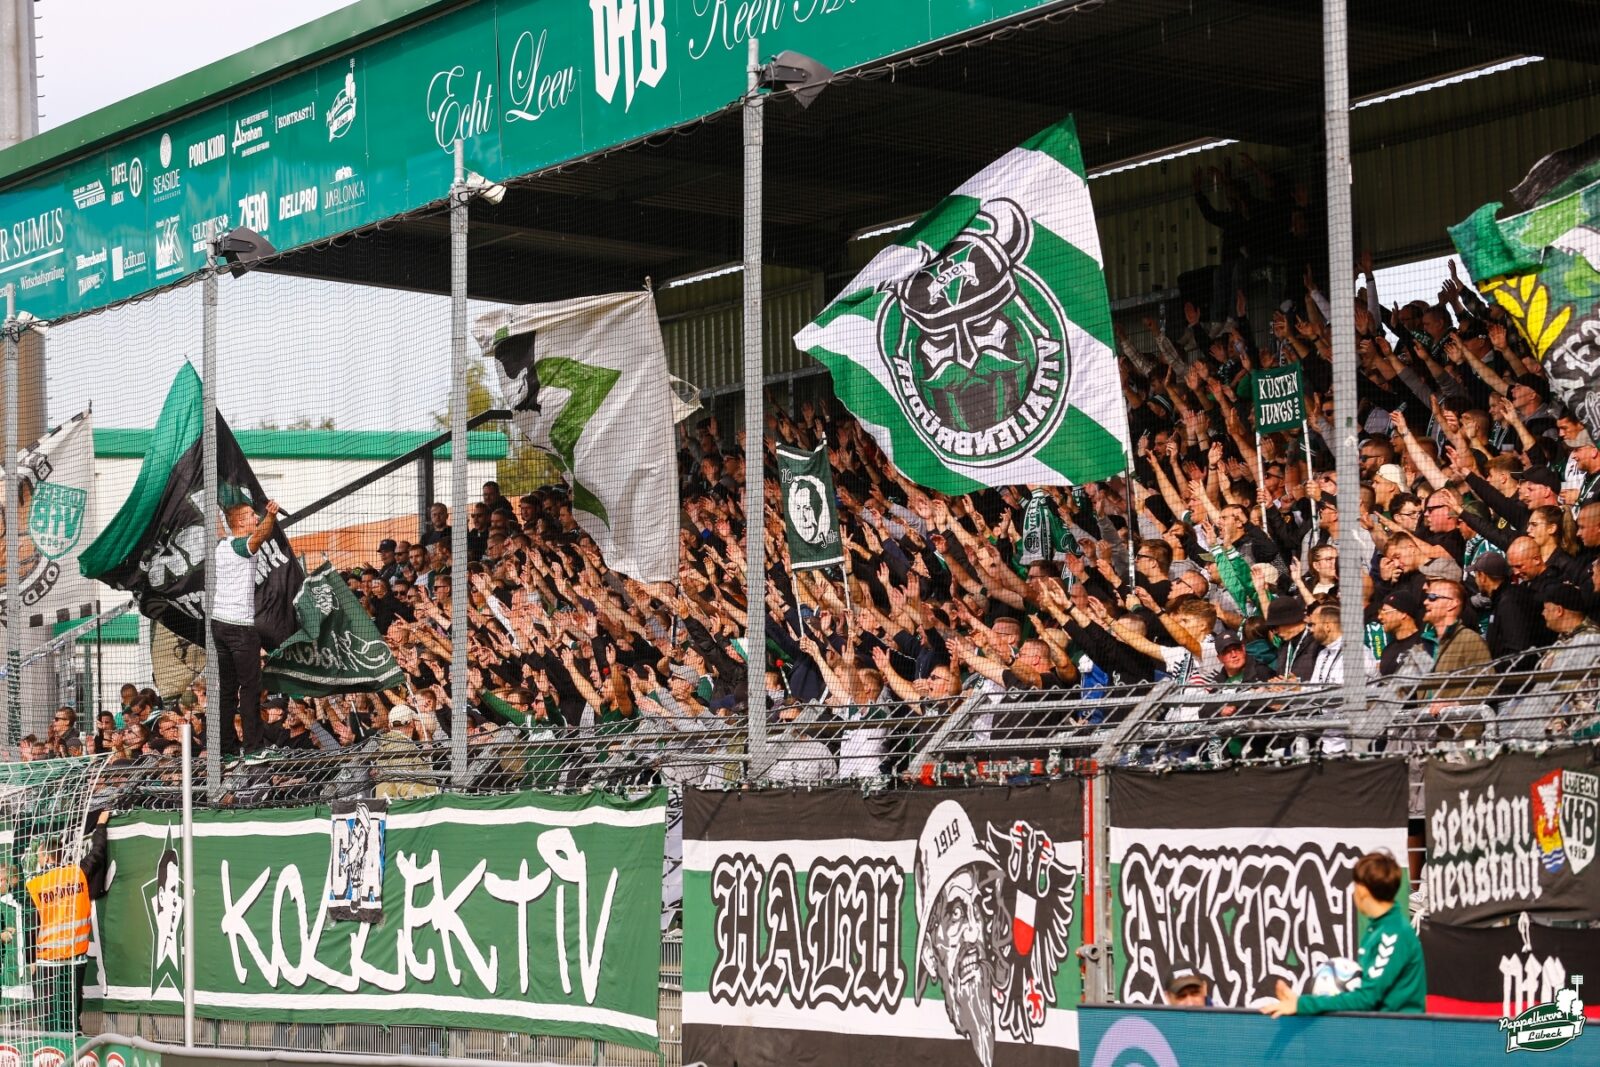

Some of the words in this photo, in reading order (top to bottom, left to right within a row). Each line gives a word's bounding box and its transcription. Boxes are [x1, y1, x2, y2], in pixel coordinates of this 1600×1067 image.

[427, 65, 493, 154] Echt
[505, 29, 576, 122] Leev
[111, 162, 128, 187] TAFEL
[153, 168, 181, 196] SEASIDE
[279, 186, 318, 221] DELLPRO
[324, 180, 366, 210] JABLONKA
[238, 191, 269, 234] ZERO
[13, 207, 65, 258] SUMUS
[1258, 371, 1298, 400] KÜSTEN
[1260, 400, 1293, 426] JUNGS
[1563, 772, 1598, 796] LÜBECK
[1561, 796, 1598, 846] VfB
[933, 818, 961, 859] 1919
